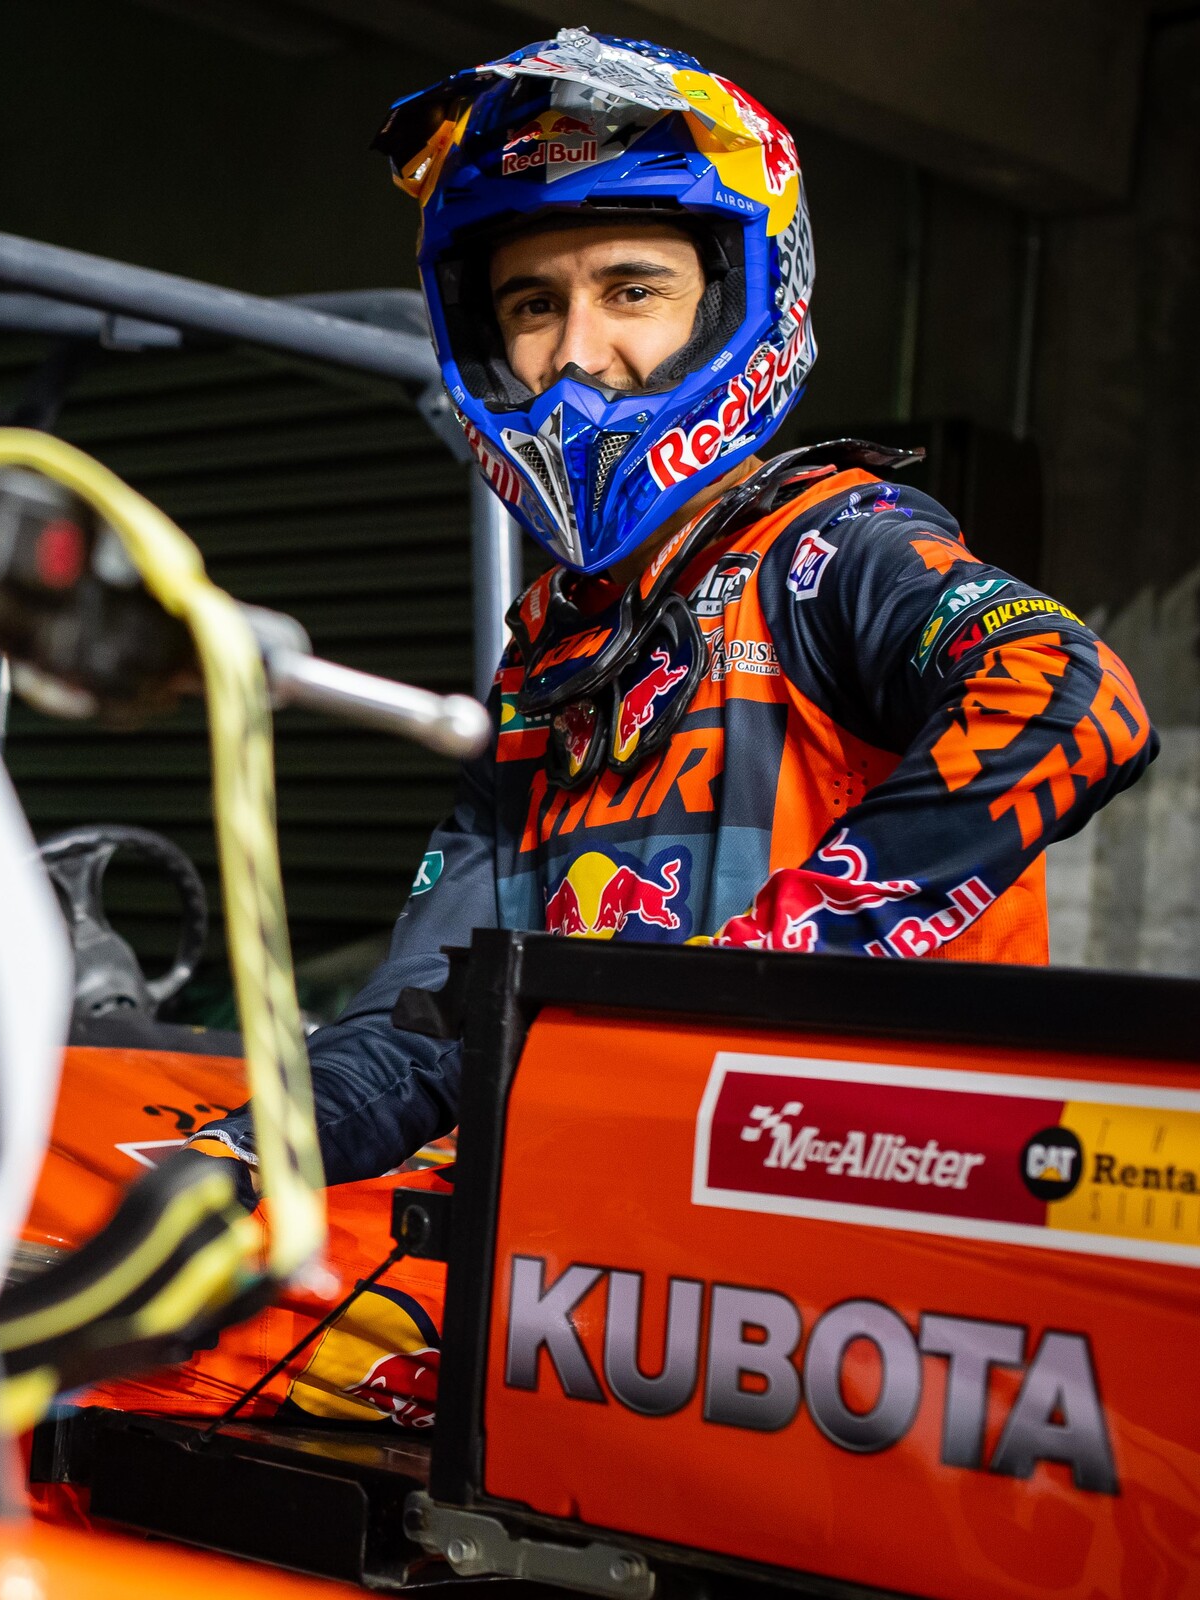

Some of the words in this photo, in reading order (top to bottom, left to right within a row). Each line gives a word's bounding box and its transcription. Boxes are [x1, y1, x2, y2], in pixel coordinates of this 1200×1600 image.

[502, 142, 546, 176] Red
[547, 140, 597, 164] Bull
[715, 191, 755, 212] AIROH
[646, 375, 750, 491] Red
[745, 297, 809, 416] Bull
[884, 876, 997, 958] Bull
[764, 1122, 986, 1189] MacAllister
[1026, 1143, 1077, 1182] CAT
[1092, 1153, 1200, 1196] Renta
[504, 1254, 1122, 1496] KUBOTA
